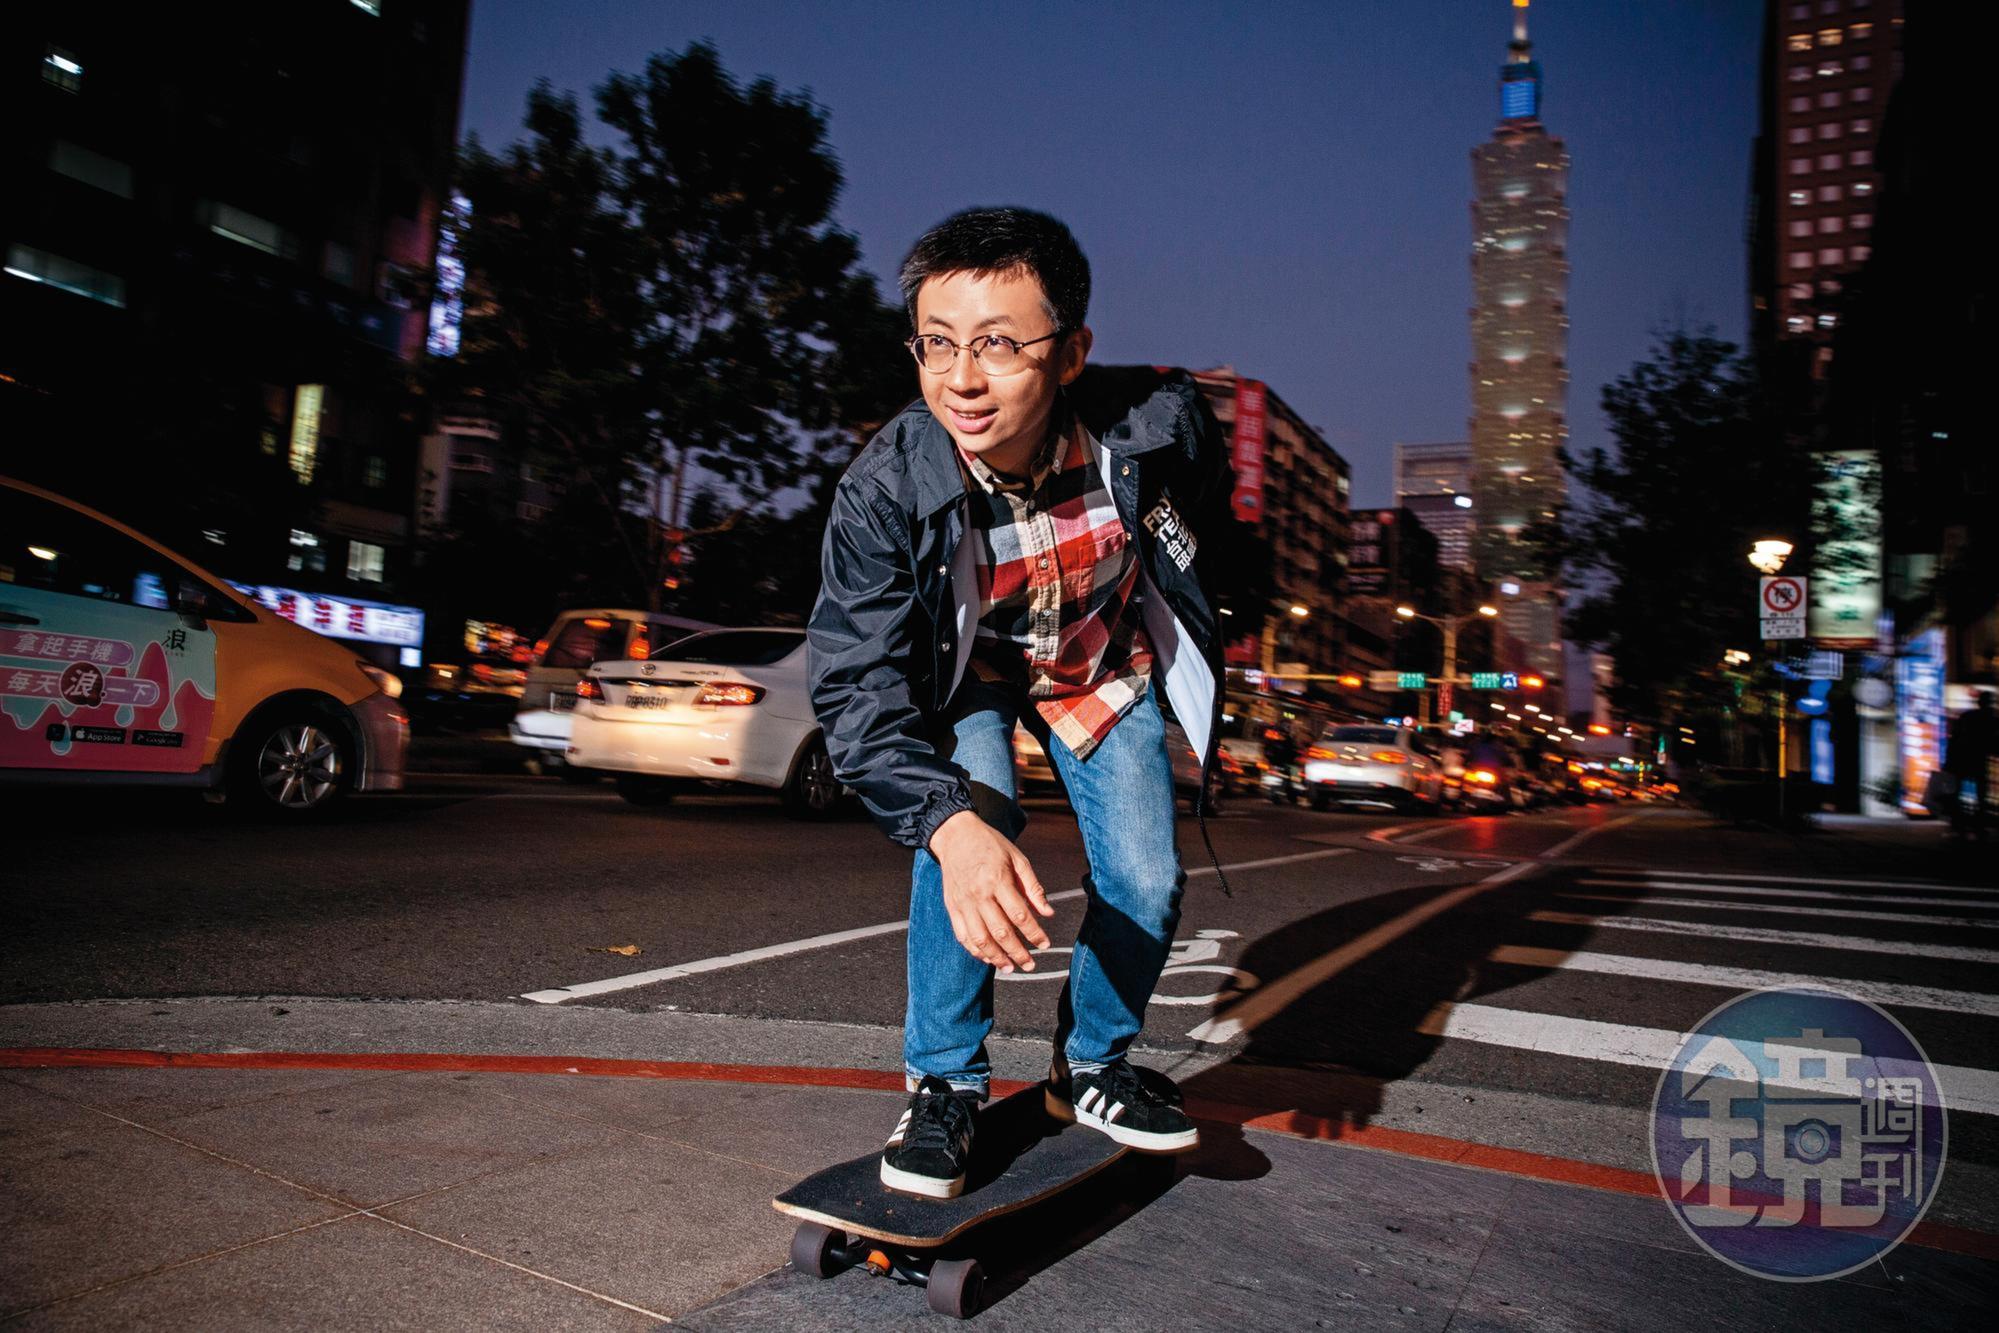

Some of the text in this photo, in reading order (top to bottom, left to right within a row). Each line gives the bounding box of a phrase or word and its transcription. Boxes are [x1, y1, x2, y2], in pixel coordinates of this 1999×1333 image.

[13, 633, 114, 662] 拿起手機
[161, 629, 186, 651] 浪
[87, 733, 102, 742] App
